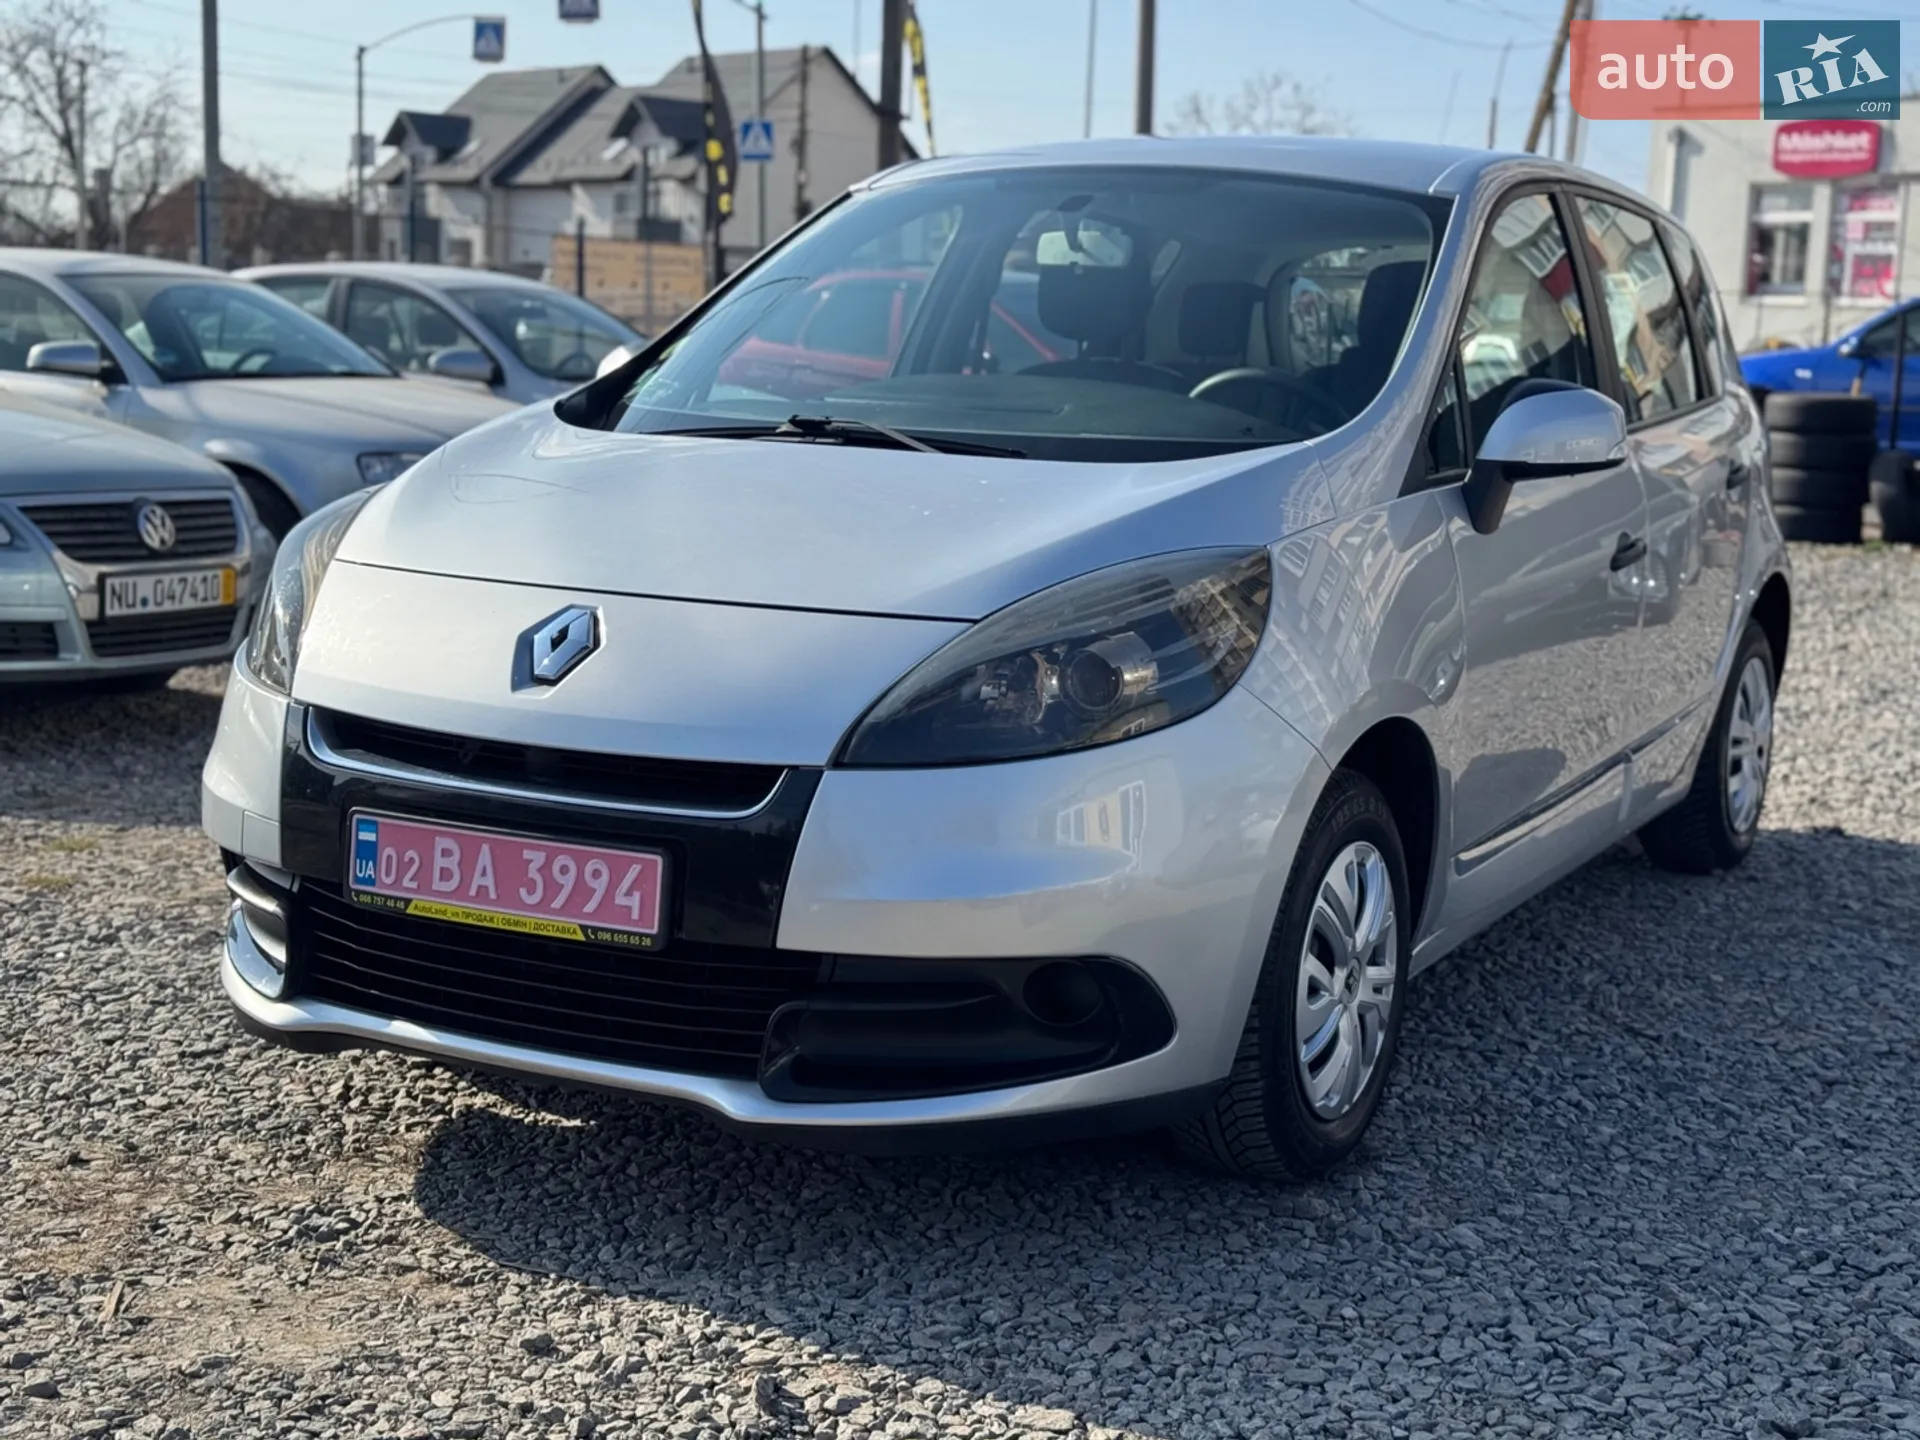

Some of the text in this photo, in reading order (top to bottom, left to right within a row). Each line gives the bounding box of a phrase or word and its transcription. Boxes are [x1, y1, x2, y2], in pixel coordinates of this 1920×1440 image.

[110, 574, 220, 611] NU 047410
[356, 859, 375, 879] UA
[380, 836, 642, 920] 02 BA 3994
[462, 911, 495, 924] ПРОДАЖ
[501, 917, 527, 928] ОБМІН
[533, 922, 578, 936] ДОСТАВКА
